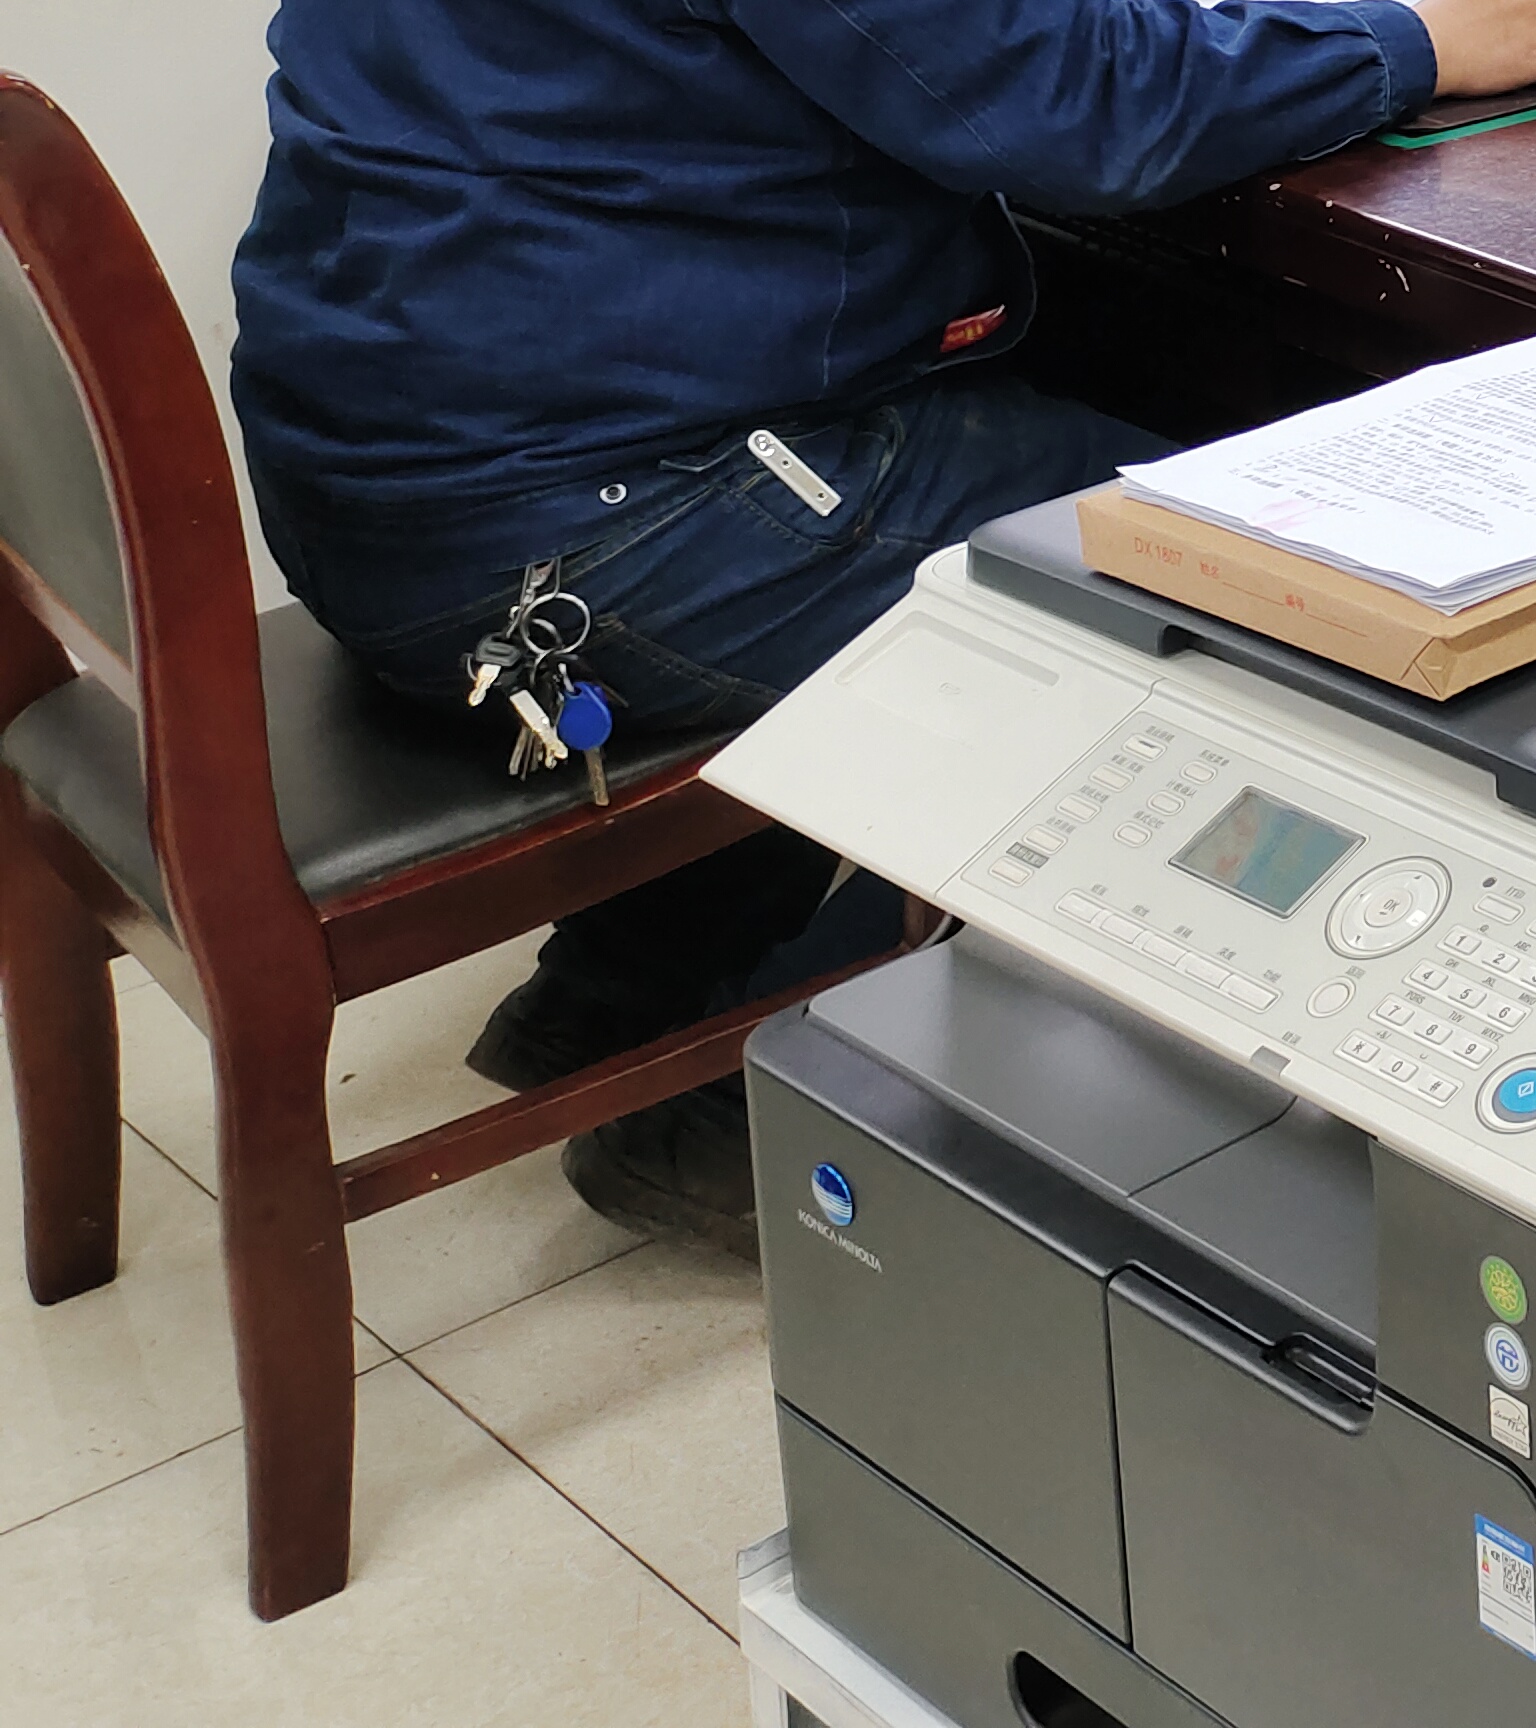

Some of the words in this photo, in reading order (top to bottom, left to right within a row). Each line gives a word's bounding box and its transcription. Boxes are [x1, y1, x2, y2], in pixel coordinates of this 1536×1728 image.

[1134, 536, 1152, 559] DX
[1156, 545, 1183, 568] 1807
[1383, 898, 1400, 912] OK
[1456, 934, 1467, 947] 1
[1492, 953, 1506, 966] 2
[1422, 969, 1434, 981] 4
[1459, 988, 1472, 1001] 5
[1498, 1007, 1511, 1019] 6
[1389, 1004, 1402, 1017] 7
[1425, 1024, 1439, 1036] 8
[1465, 1043, 1478, 1056] 9
[1391, 1059, 1404, 1072] 0
[797, 1208, 838, 1246] KONICA
[838, 1234, 883, 1274] MINOLTA
